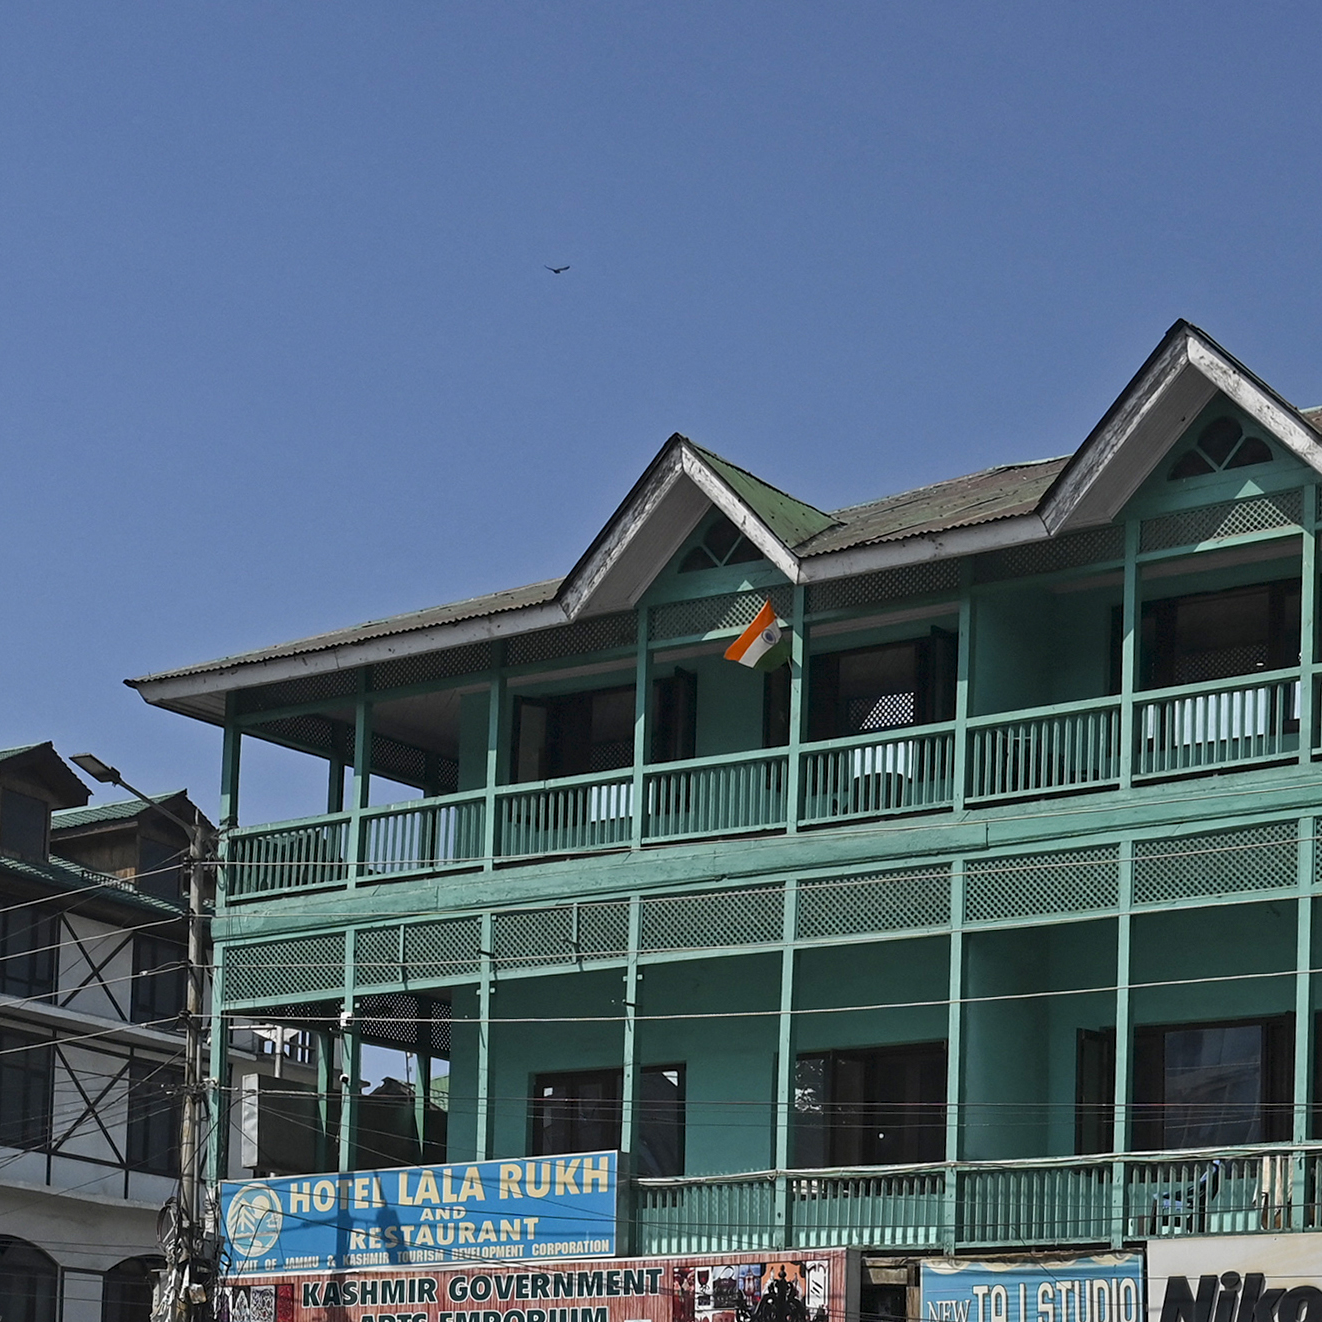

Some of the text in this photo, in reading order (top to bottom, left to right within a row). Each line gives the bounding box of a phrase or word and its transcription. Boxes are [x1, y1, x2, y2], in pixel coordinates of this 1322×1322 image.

[289, 1156, 609, 1214] HOTEL LALA RUKH
[420, 1206, 467, 1222] AND
[349, 1217, 539, 1251] RESTAURANT
[236, 1239, 610, 1273] UNIT OF JAMMU & KASHMIR TOURISM DEVELOPMENT CORPORATION
[301, 1266, 665, 1309] KASHMIR GOVERNMENT
